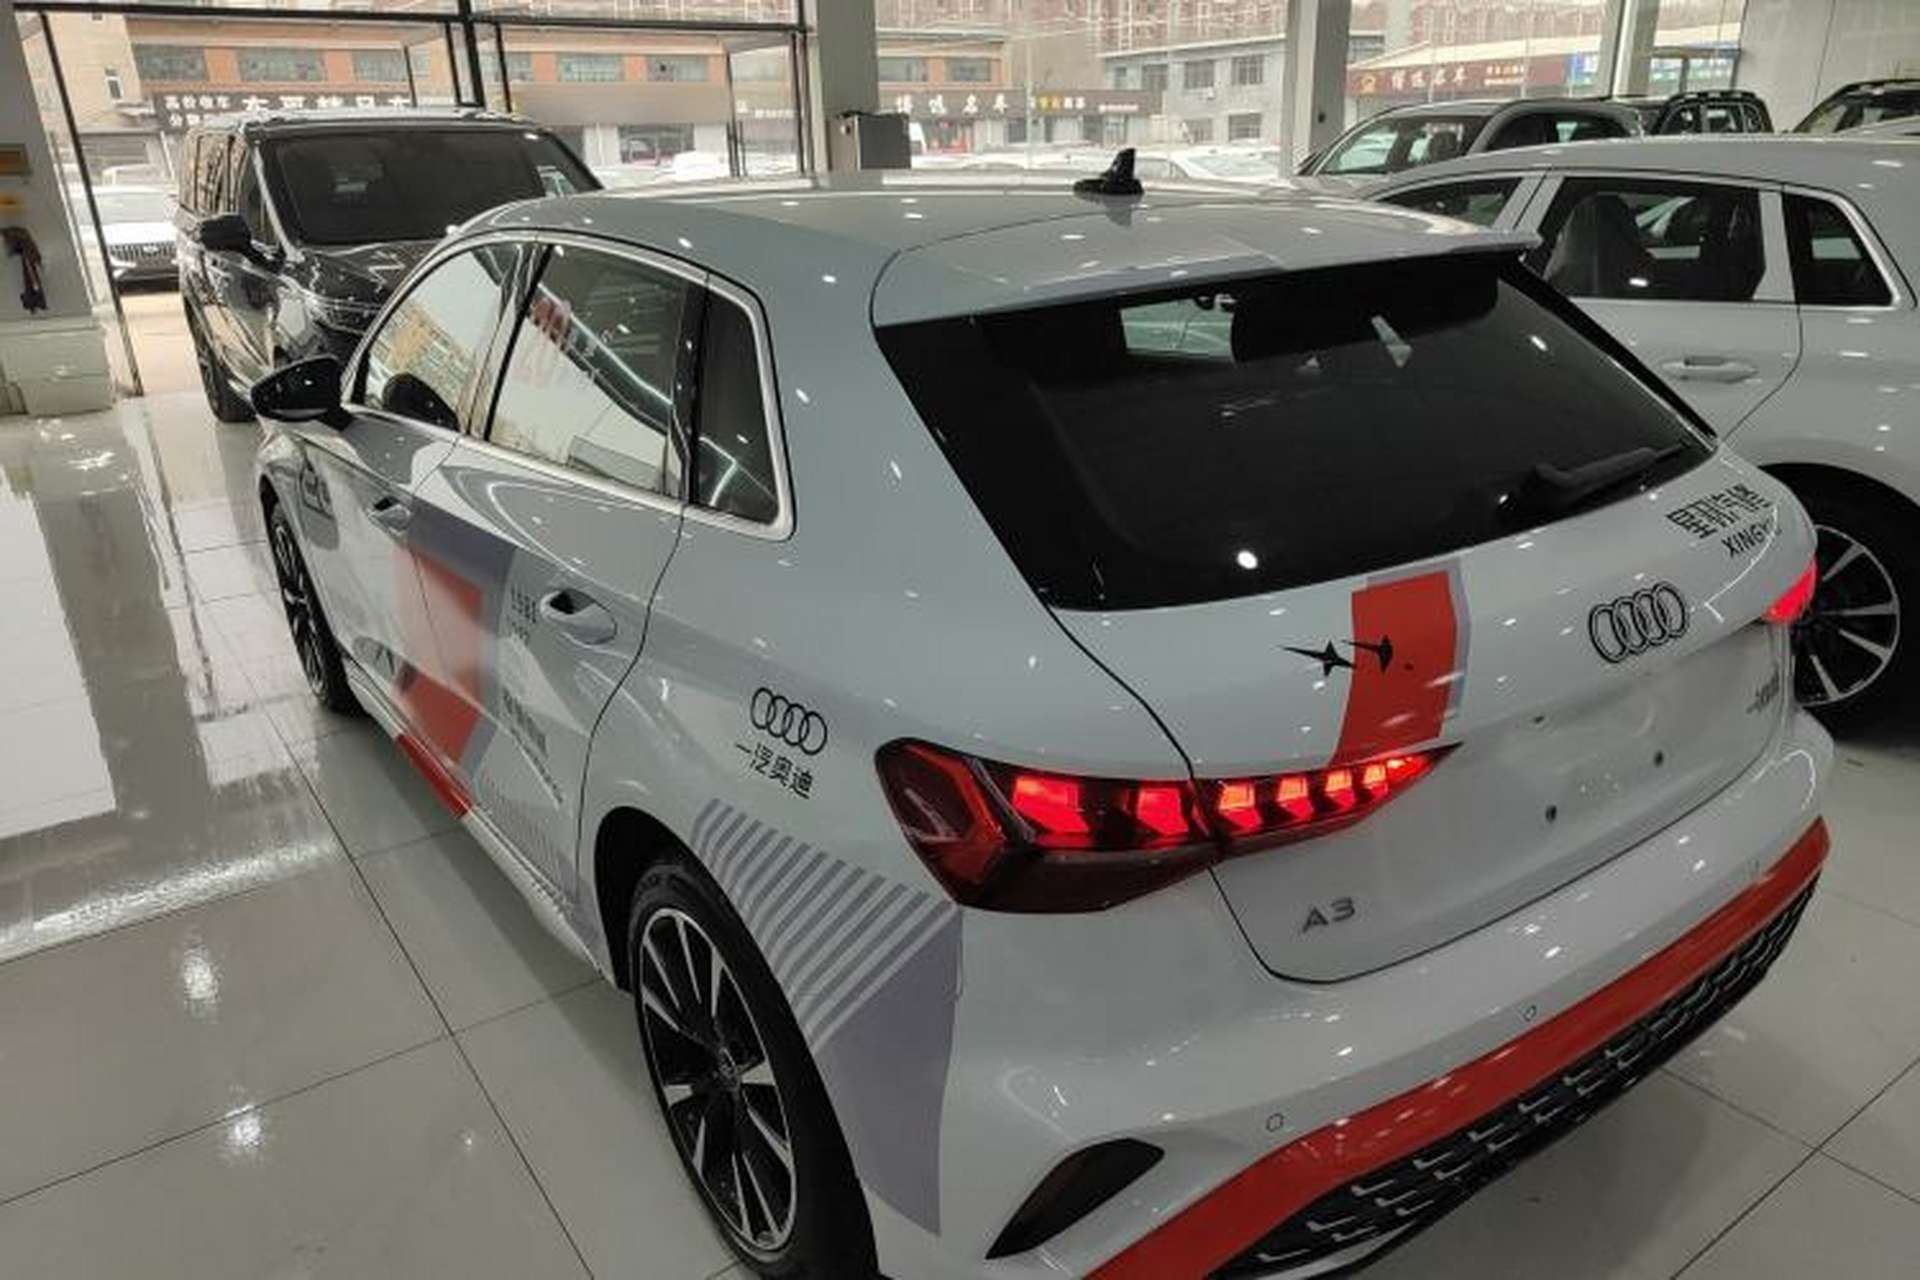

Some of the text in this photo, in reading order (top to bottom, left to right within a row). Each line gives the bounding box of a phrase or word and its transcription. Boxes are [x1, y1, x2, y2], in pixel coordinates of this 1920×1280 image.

[736, 743, 813, 799] 一汽奥迪
[1302, 896, 1356, 934] A3
